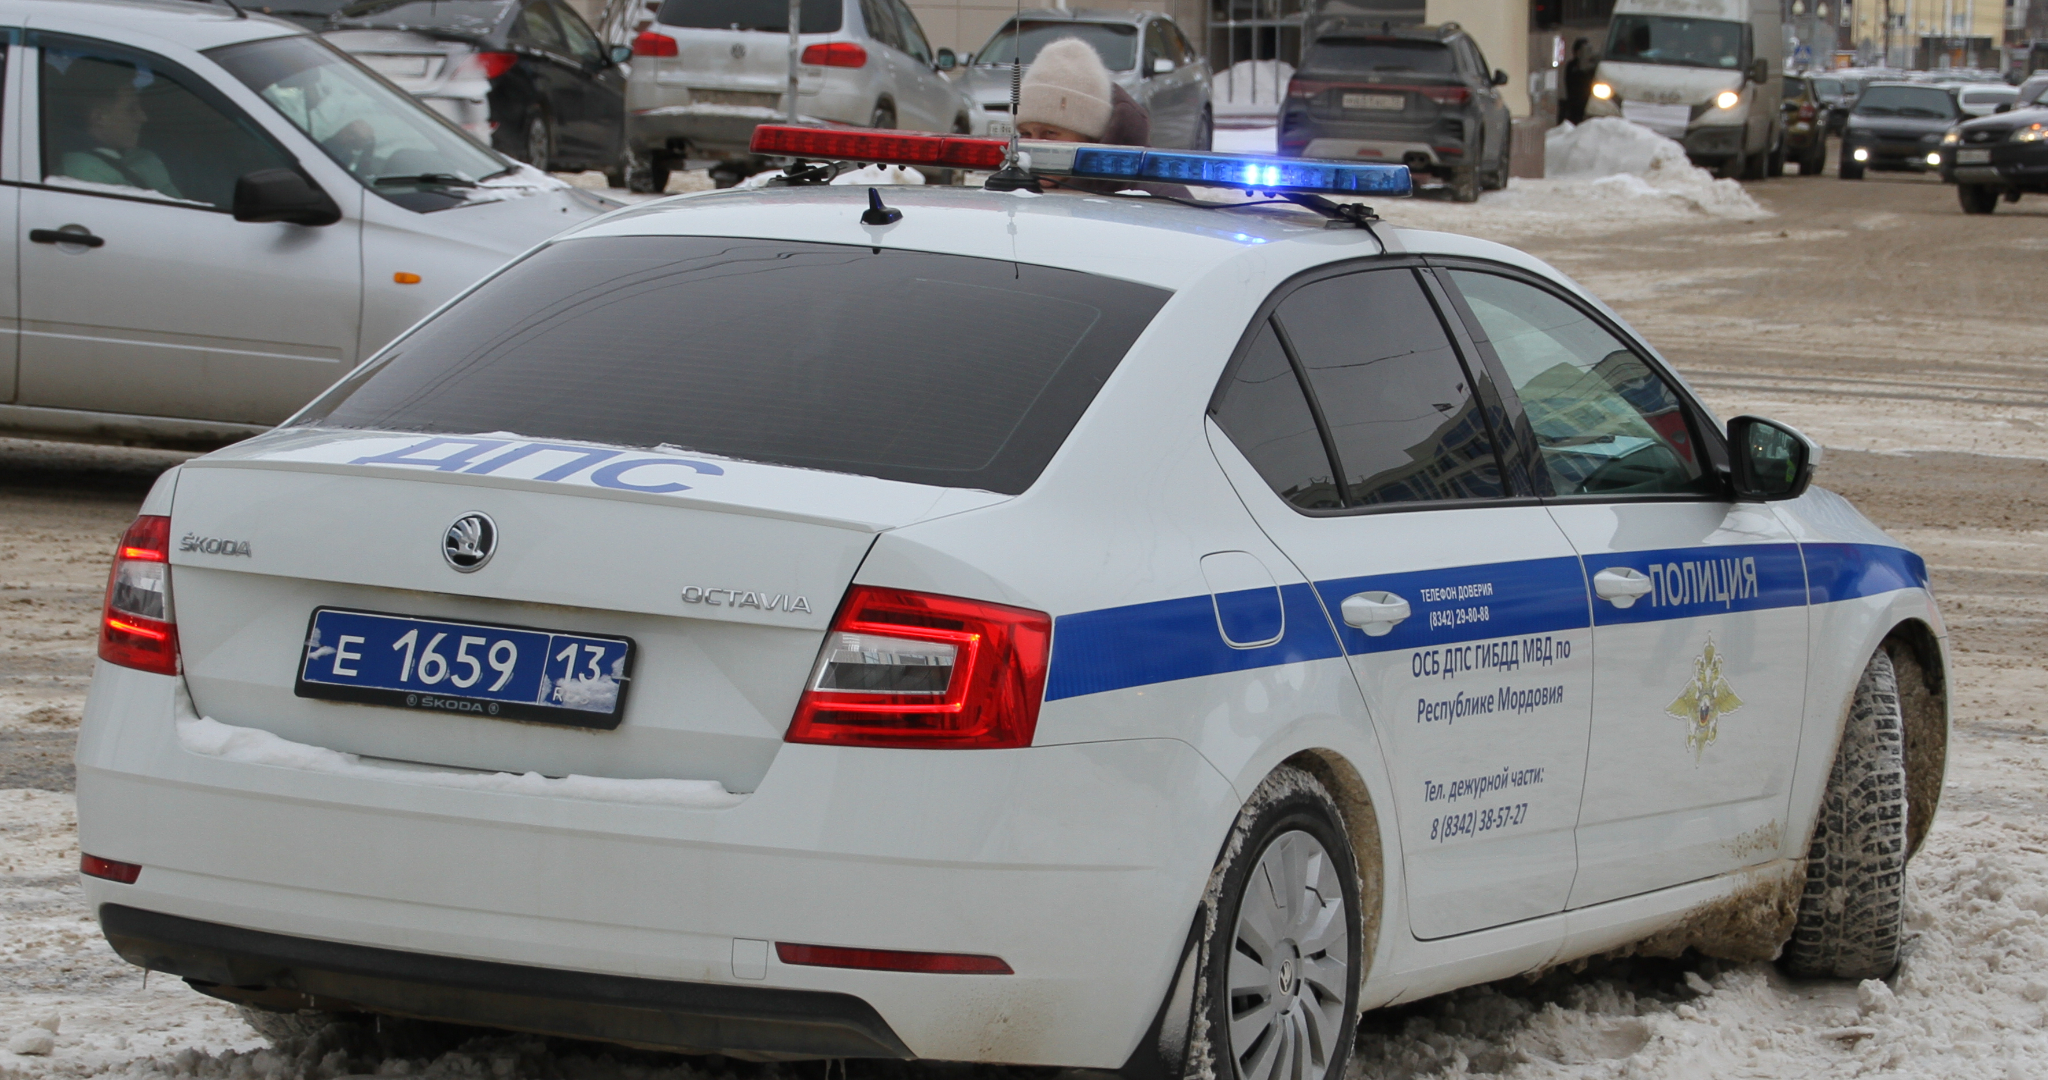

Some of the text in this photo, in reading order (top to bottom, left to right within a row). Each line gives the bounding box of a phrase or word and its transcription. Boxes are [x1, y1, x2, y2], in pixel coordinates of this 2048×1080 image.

[346, 437, 725, 493] ДПС
[179, 532, 252, 558] ŠKODA
[681, 585, 812, 614] OCTAVIA
[1420, 582, 1493, 602] ТЕЛЕФОН ДОВЕРИЯ
[1648, 556, 1758, 609] ПОЛИЦИЯ
[1429, 605, 1490, 631] (8342) 29-80-88
[332, 629, 605, 692] Е 1659 13
[1412, 636, 1571, 680] ОСБ ДПС ГИБДД МВД по
[421, 697, 483, 713] ŠKODA
[1417, 685, 1564, 726] Республике Мордовия
[1424, 766, 1545, 803] Тел. дежурной части:
[1430, 802, 1528, 844] 8 (8342) 38-57-27
